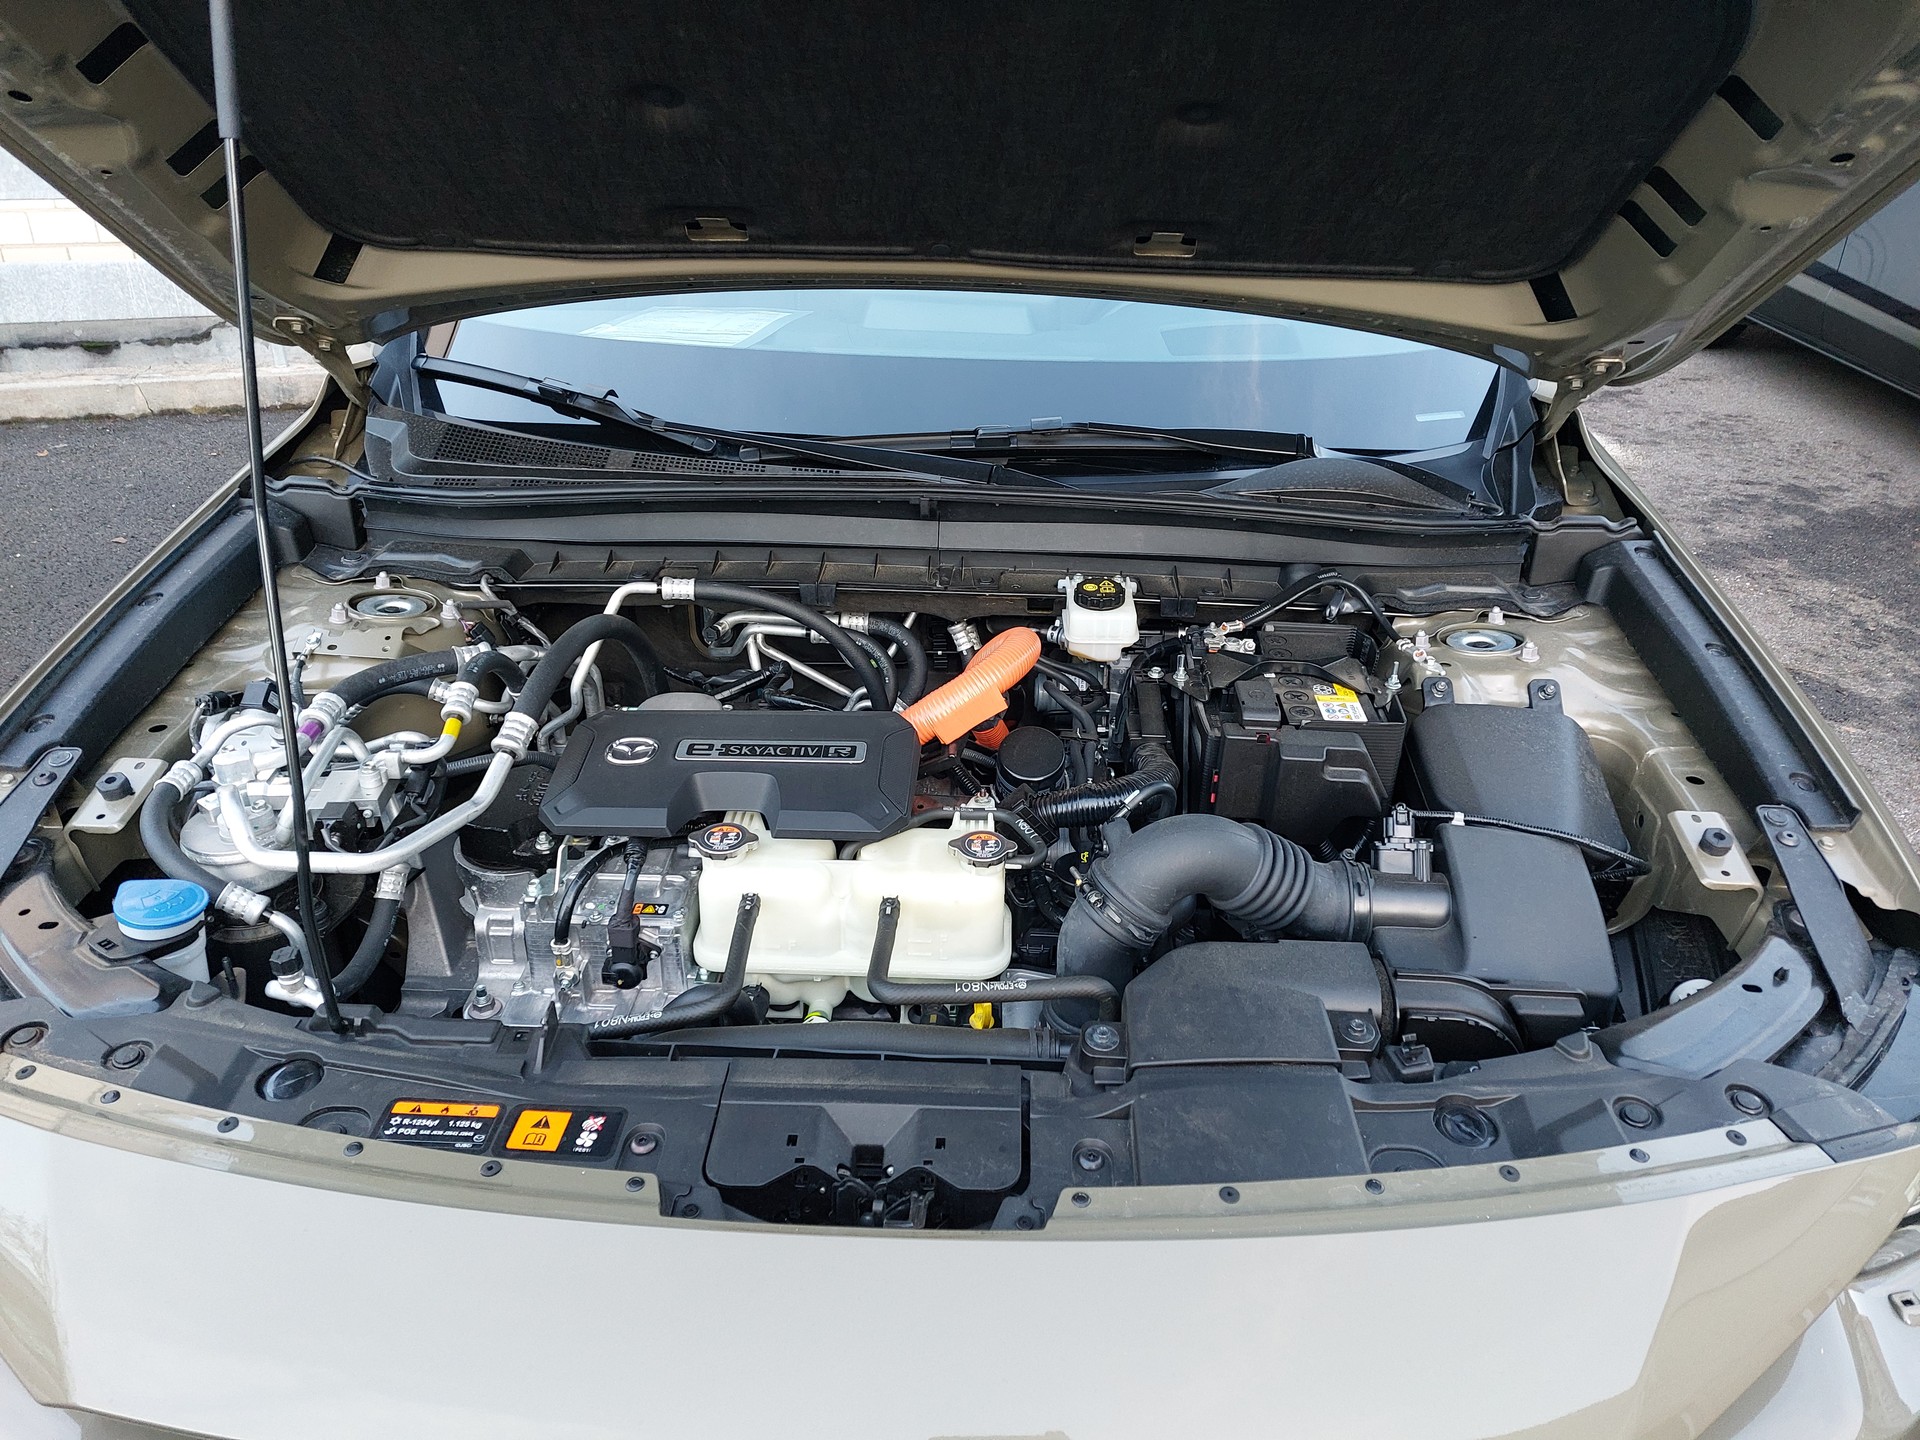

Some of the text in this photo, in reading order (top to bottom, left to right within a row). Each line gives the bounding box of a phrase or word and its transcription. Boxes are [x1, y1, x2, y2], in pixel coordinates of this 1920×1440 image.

[402, 1119, 483, 1130] R-1234yf 1.125 kg
[397, 1128, 418, 1136] POE
